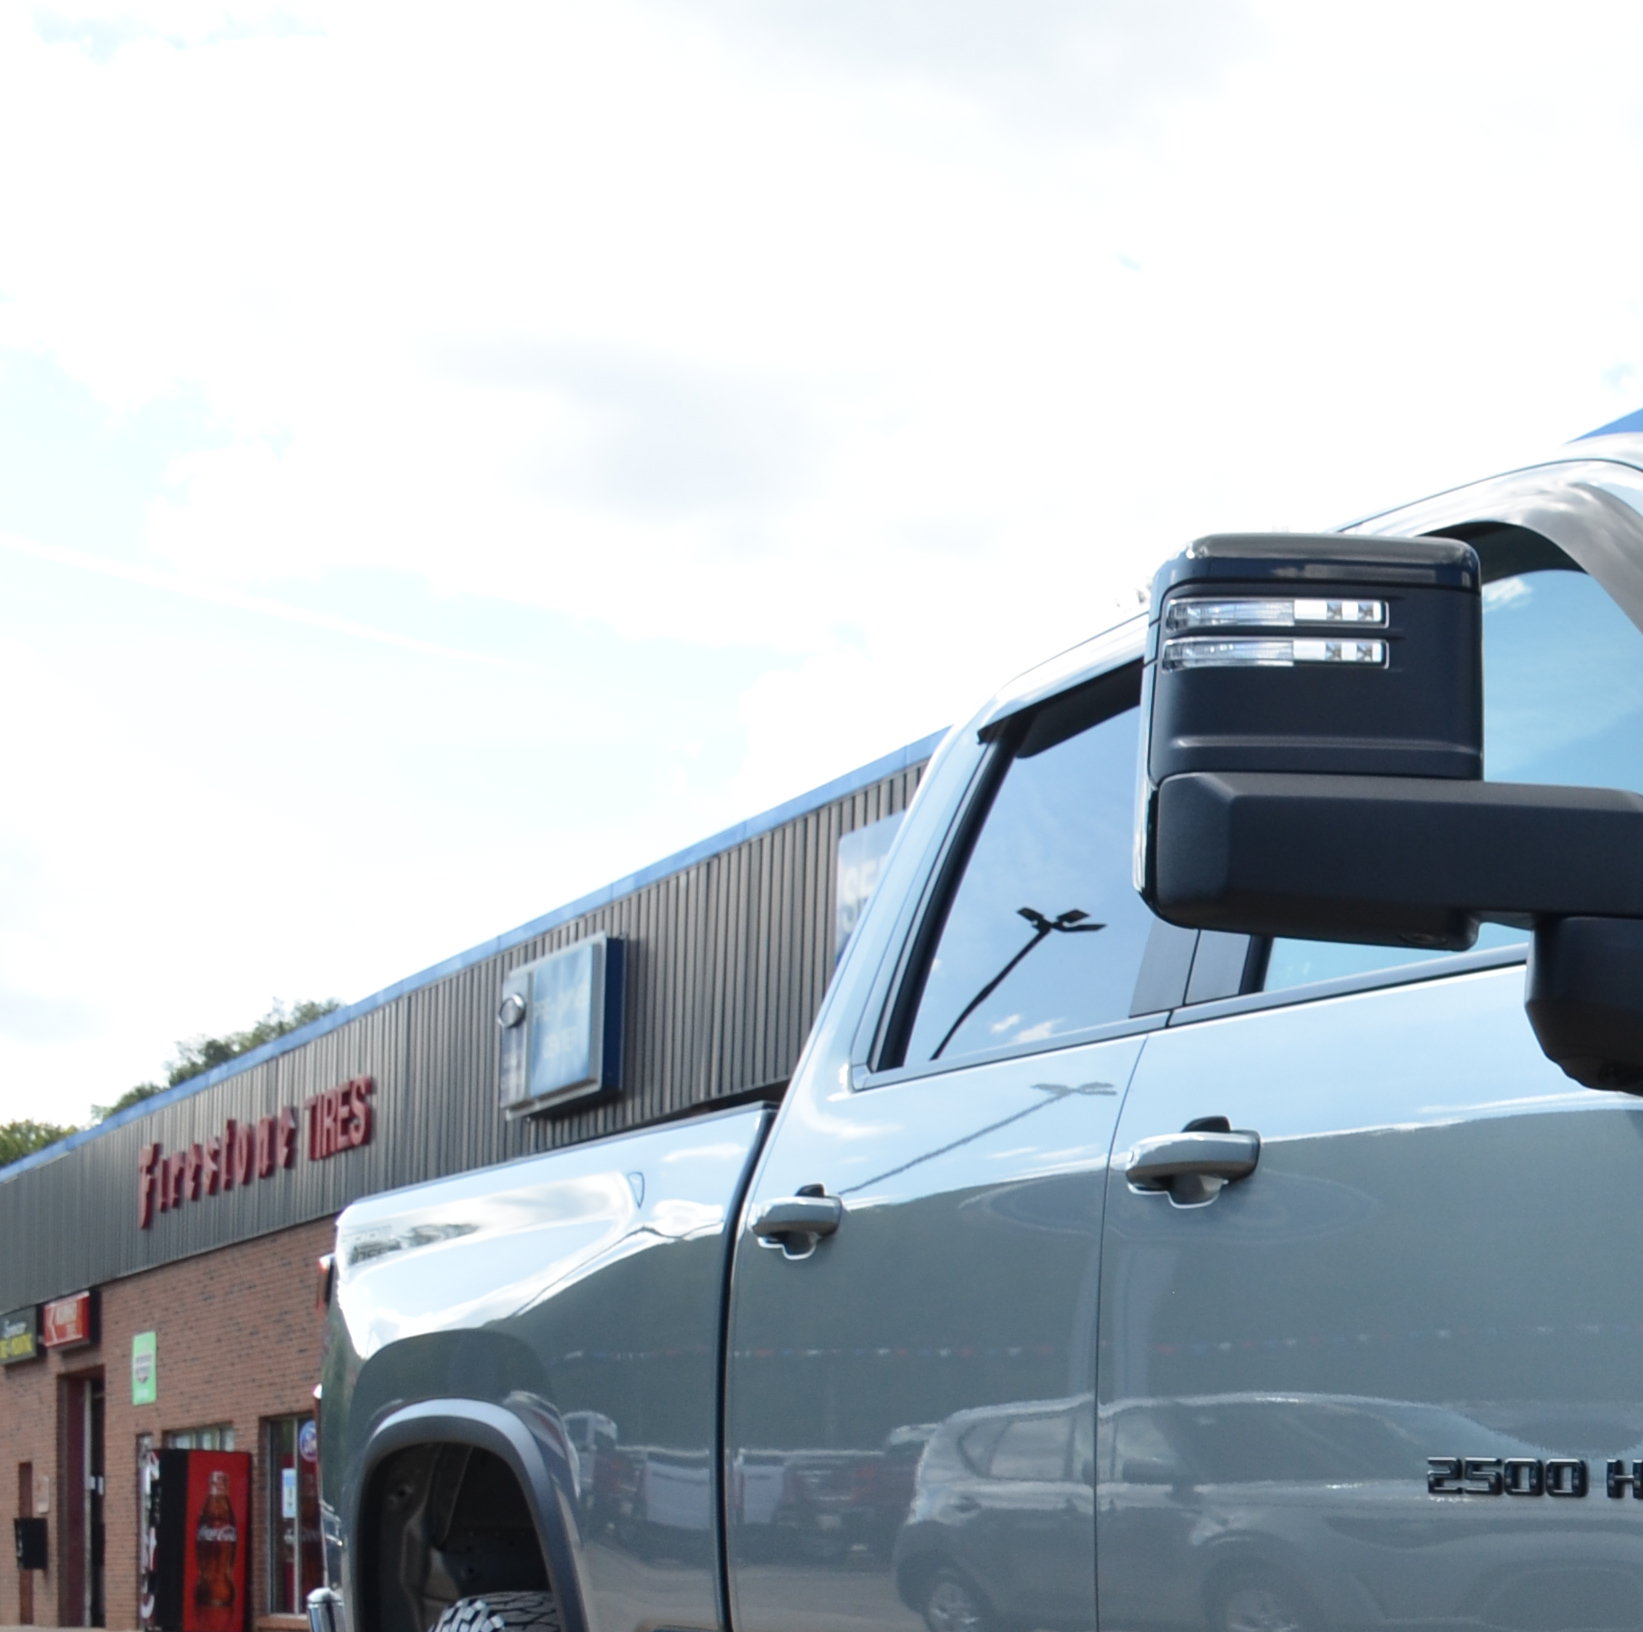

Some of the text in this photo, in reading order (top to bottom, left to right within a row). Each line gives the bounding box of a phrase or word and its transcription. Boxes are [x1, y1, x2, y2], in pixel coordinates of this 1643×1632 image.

[138, 1076, 374, 1229] Firestone TIRES
[1427, 1456, 1589, 1498] 2500
